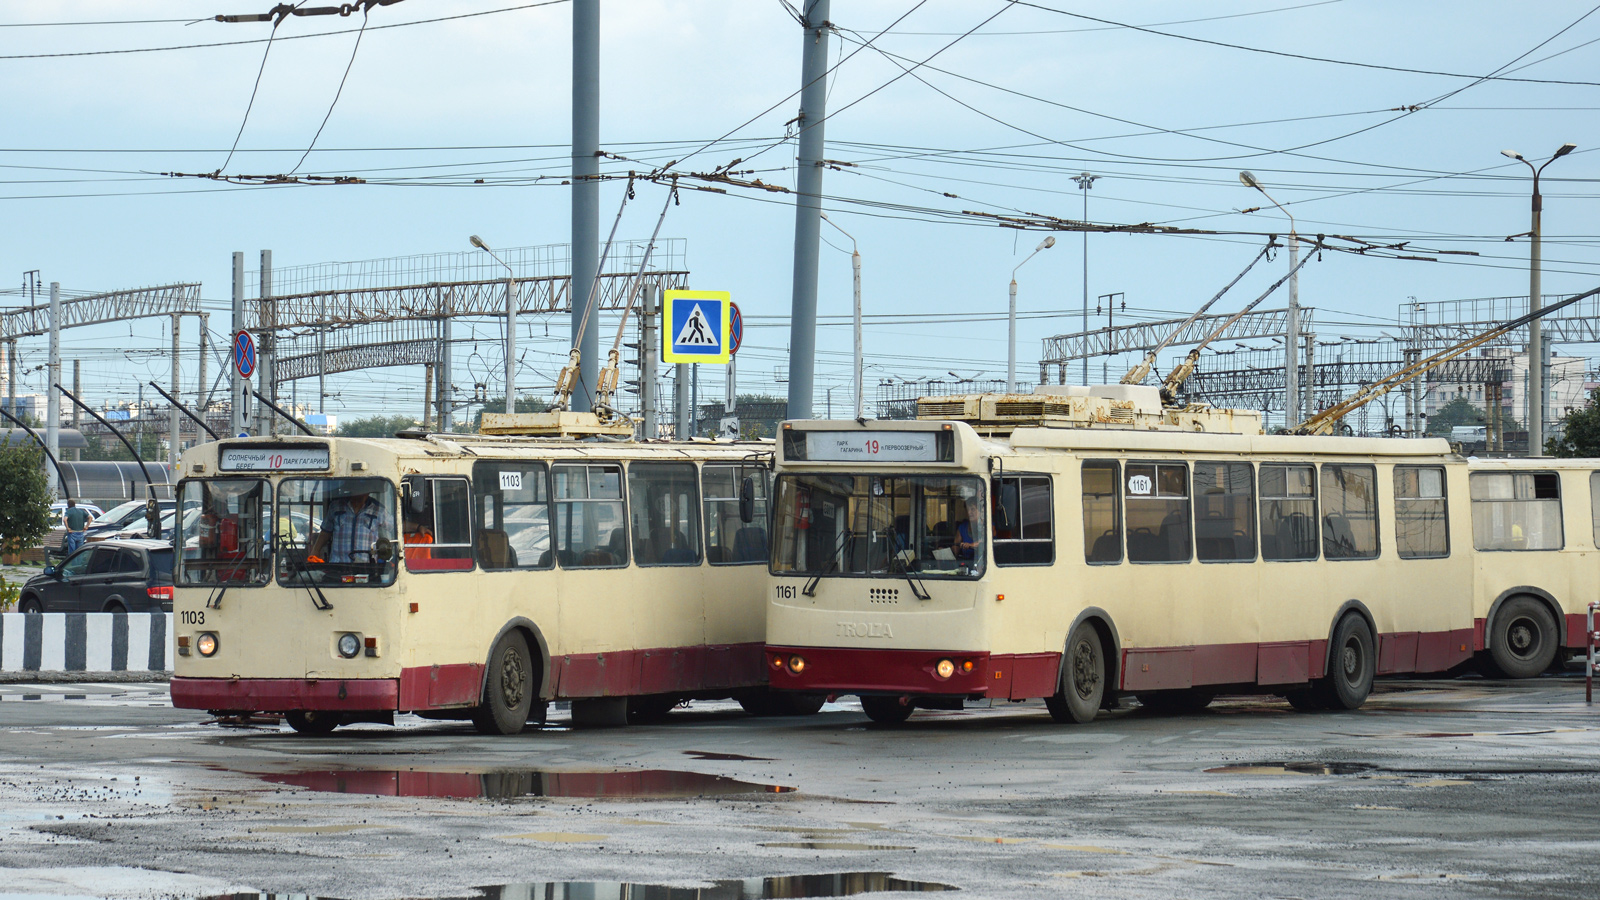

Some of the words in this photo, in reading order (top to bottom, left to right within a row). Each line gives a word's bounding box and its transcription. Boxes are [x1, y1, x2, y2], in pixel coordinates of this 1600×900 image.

[865, 439, 879, 454] 19
[227, 453, 266, 462] СОЛНЕЧНЫЙ
[268, 454, 283, 469] 10
[235, 462, 255, 470] БЕРЕГ
[501, 474, 520, 487] 1103
[1132, 479, 1148, 491] 1161
[775, 585, 797, 599] 1161
[180, 610, 206, 625] 1103
